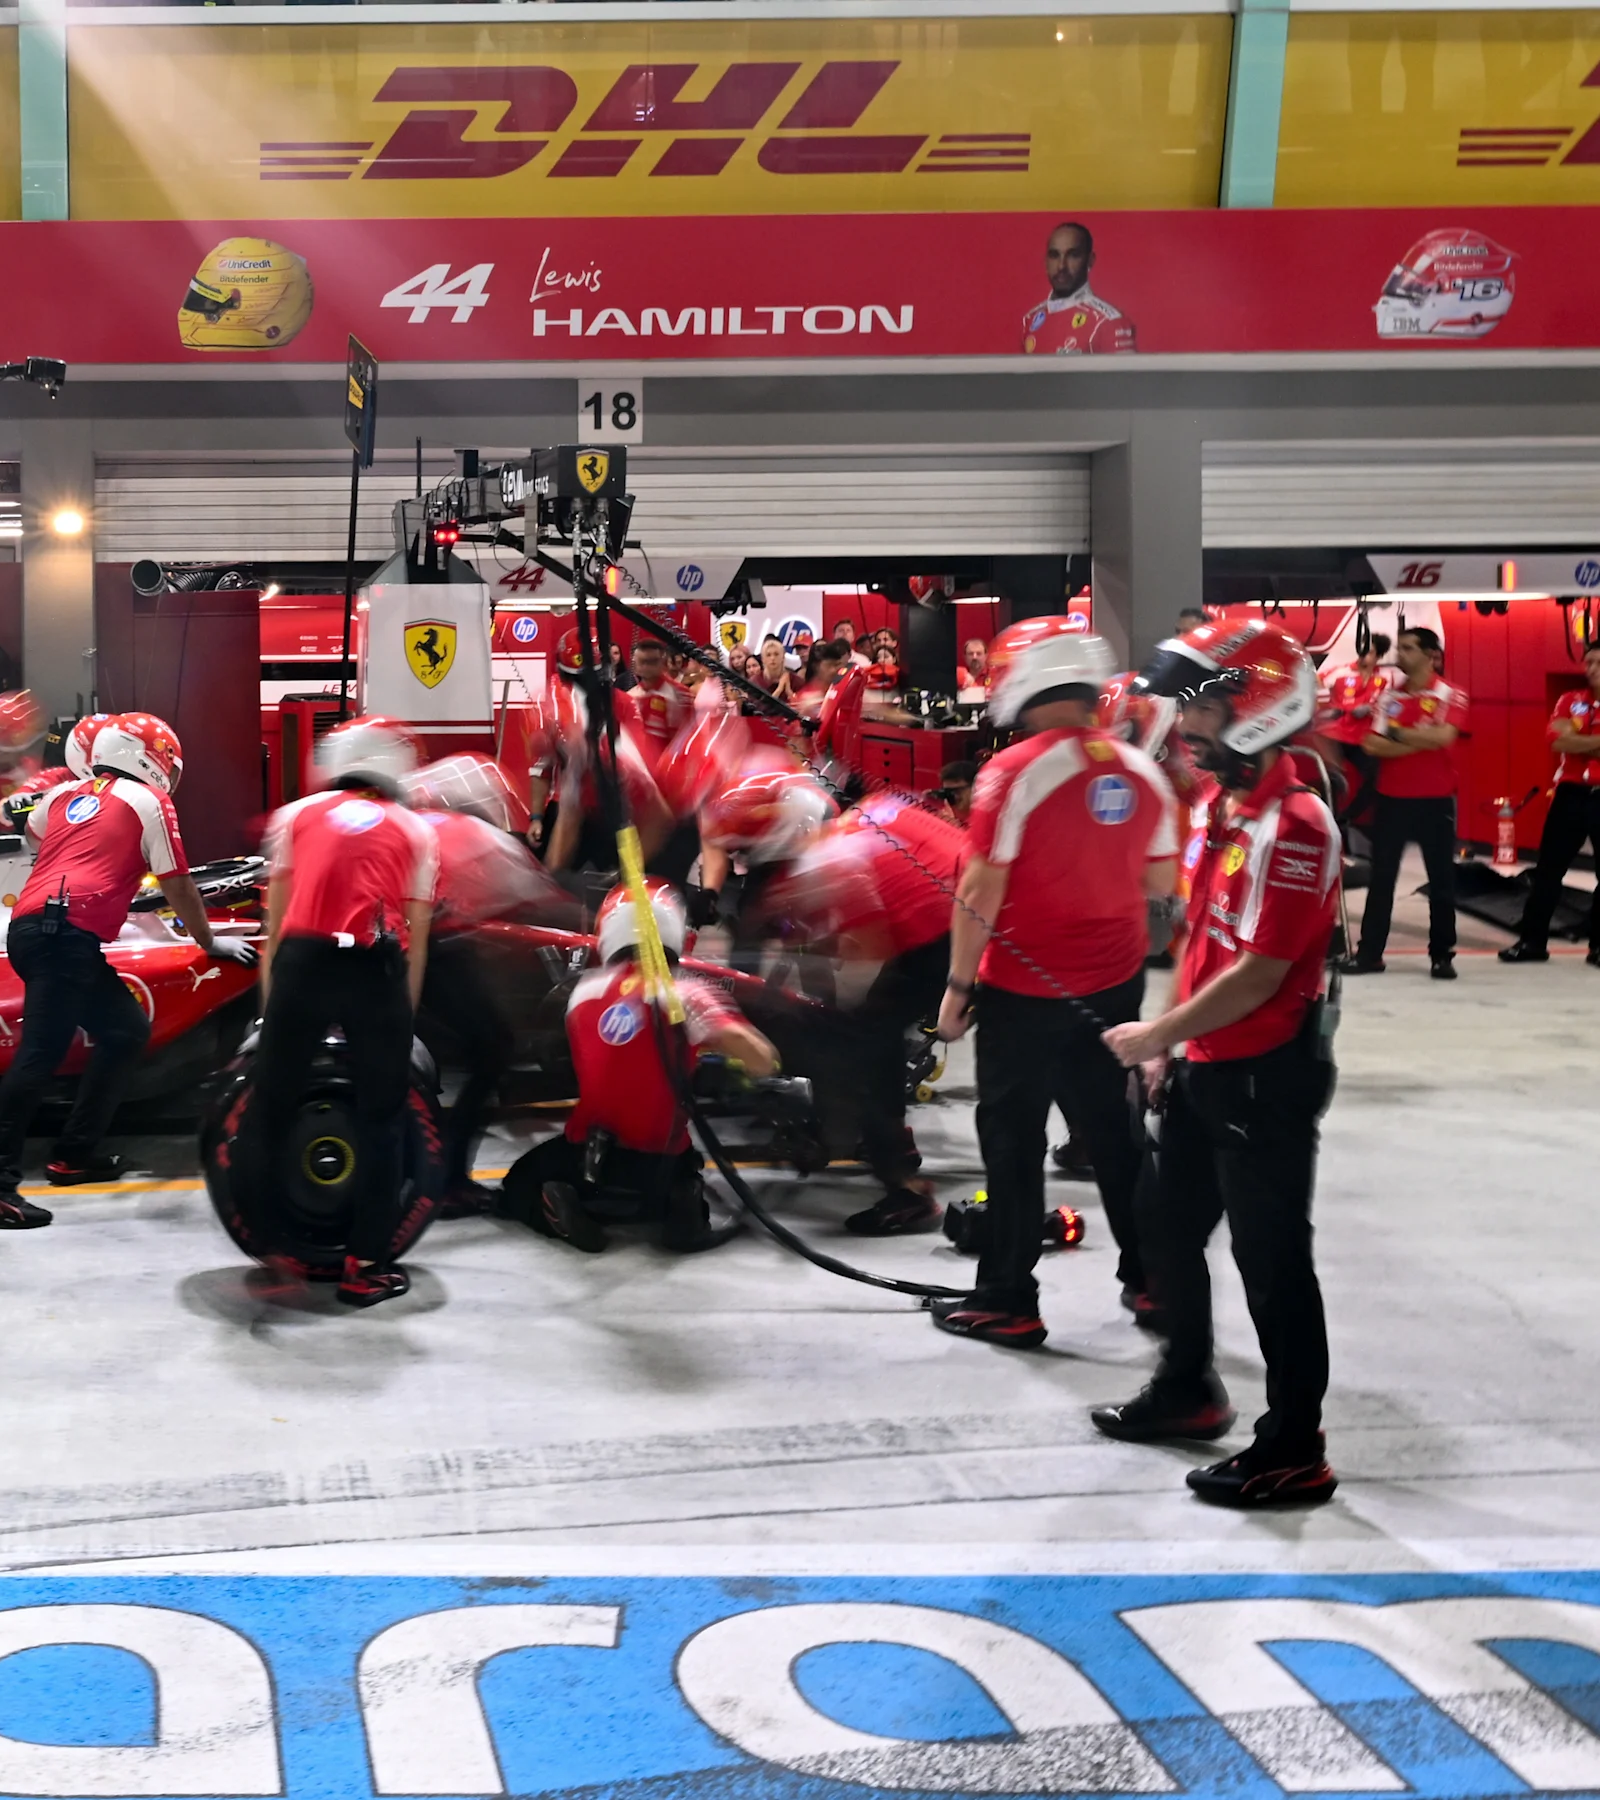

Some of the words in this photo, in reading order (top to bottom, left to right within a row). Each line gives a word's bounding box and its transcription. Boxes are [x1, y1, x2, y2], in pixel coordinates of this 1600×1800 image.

[362, 61, 930, 180] DHL
[227, 258, 272, 270] UniCredit
[528, 246, 603, 303] Lewis
[219, 274, 269, 284] Bitdefender
[1452, 276, 1505, 302] 16
[379, 262, 495, 324] 44
[532, 304, 915, 338] HAMILTON
[1392, 316, 1421, 333] IBM
[584, 391, 637, 431] 18
[498, 565, 546, 592] 44
[679, 564, 702, 592] hp
[1394, 560, 1445, 589] 16
[515, 617, 537, 641] hp
[200, 872, 255, 898] DXC
